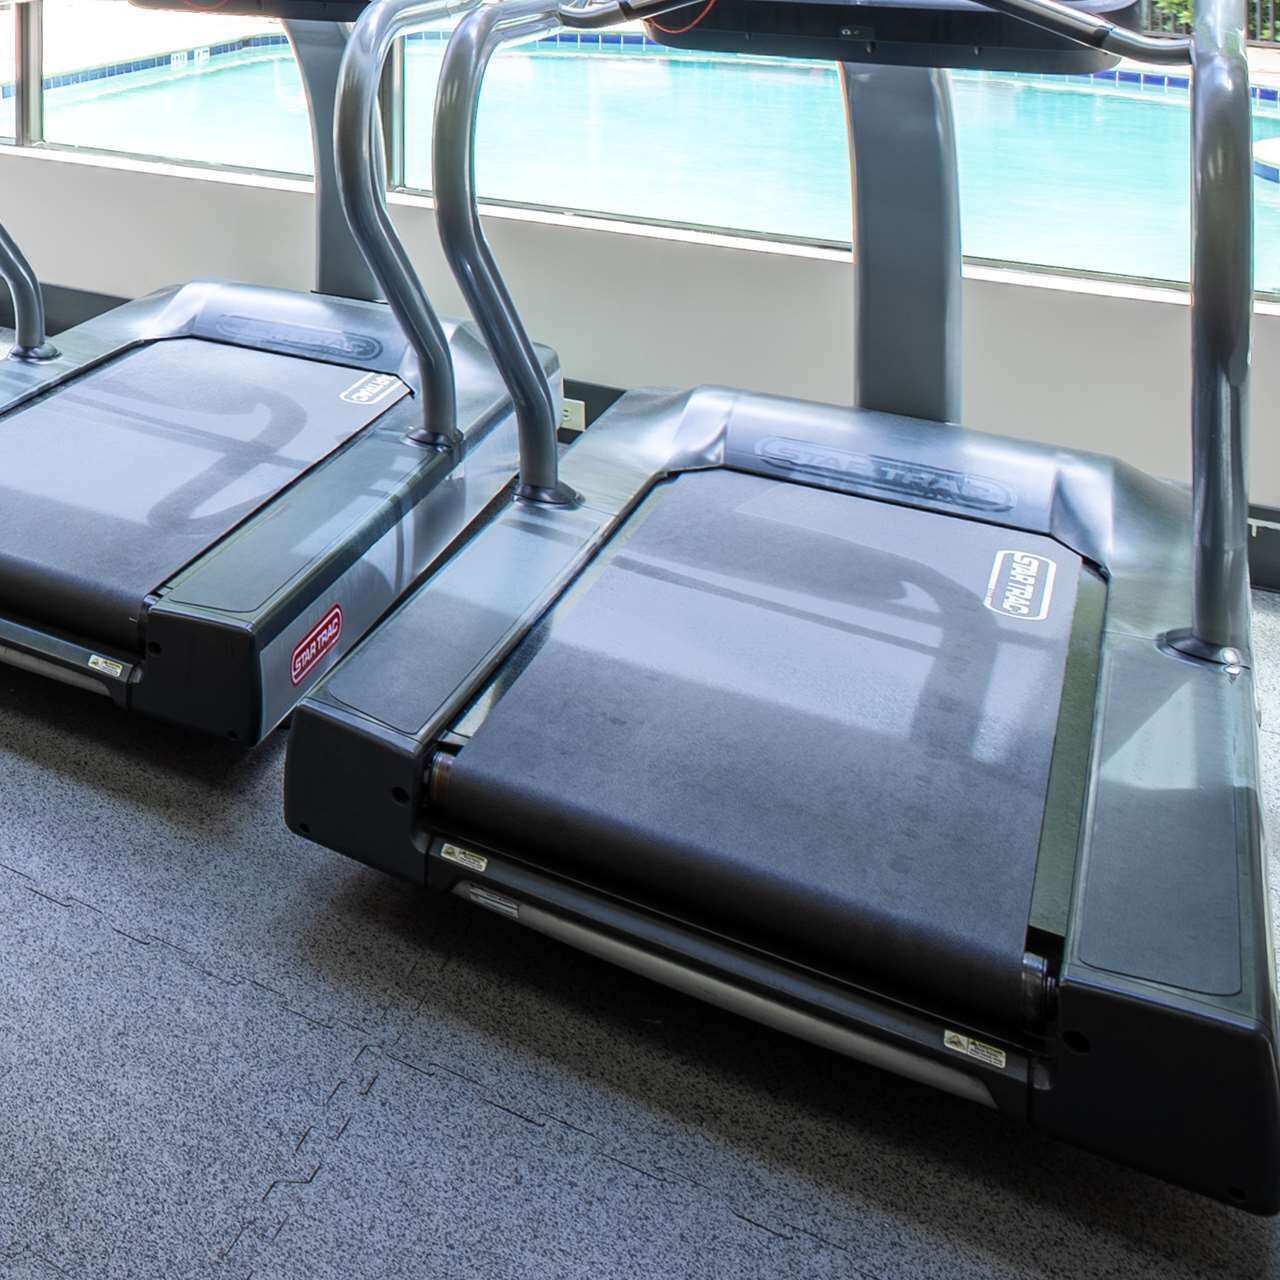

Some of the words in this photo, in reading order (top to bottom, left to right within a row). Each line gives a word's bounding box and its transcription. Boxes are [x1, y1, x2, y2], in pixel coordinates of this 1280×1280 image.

[779, 446, 870, 478] STAR
[880, 467, 1002, 501] TRAC
[1008, 552, 1040, 585] STAR
[1002, 581, 1035, 614] TRAC
[295, 643, 316, 672] STAR
[317, 618, 338, 650] TRAC
